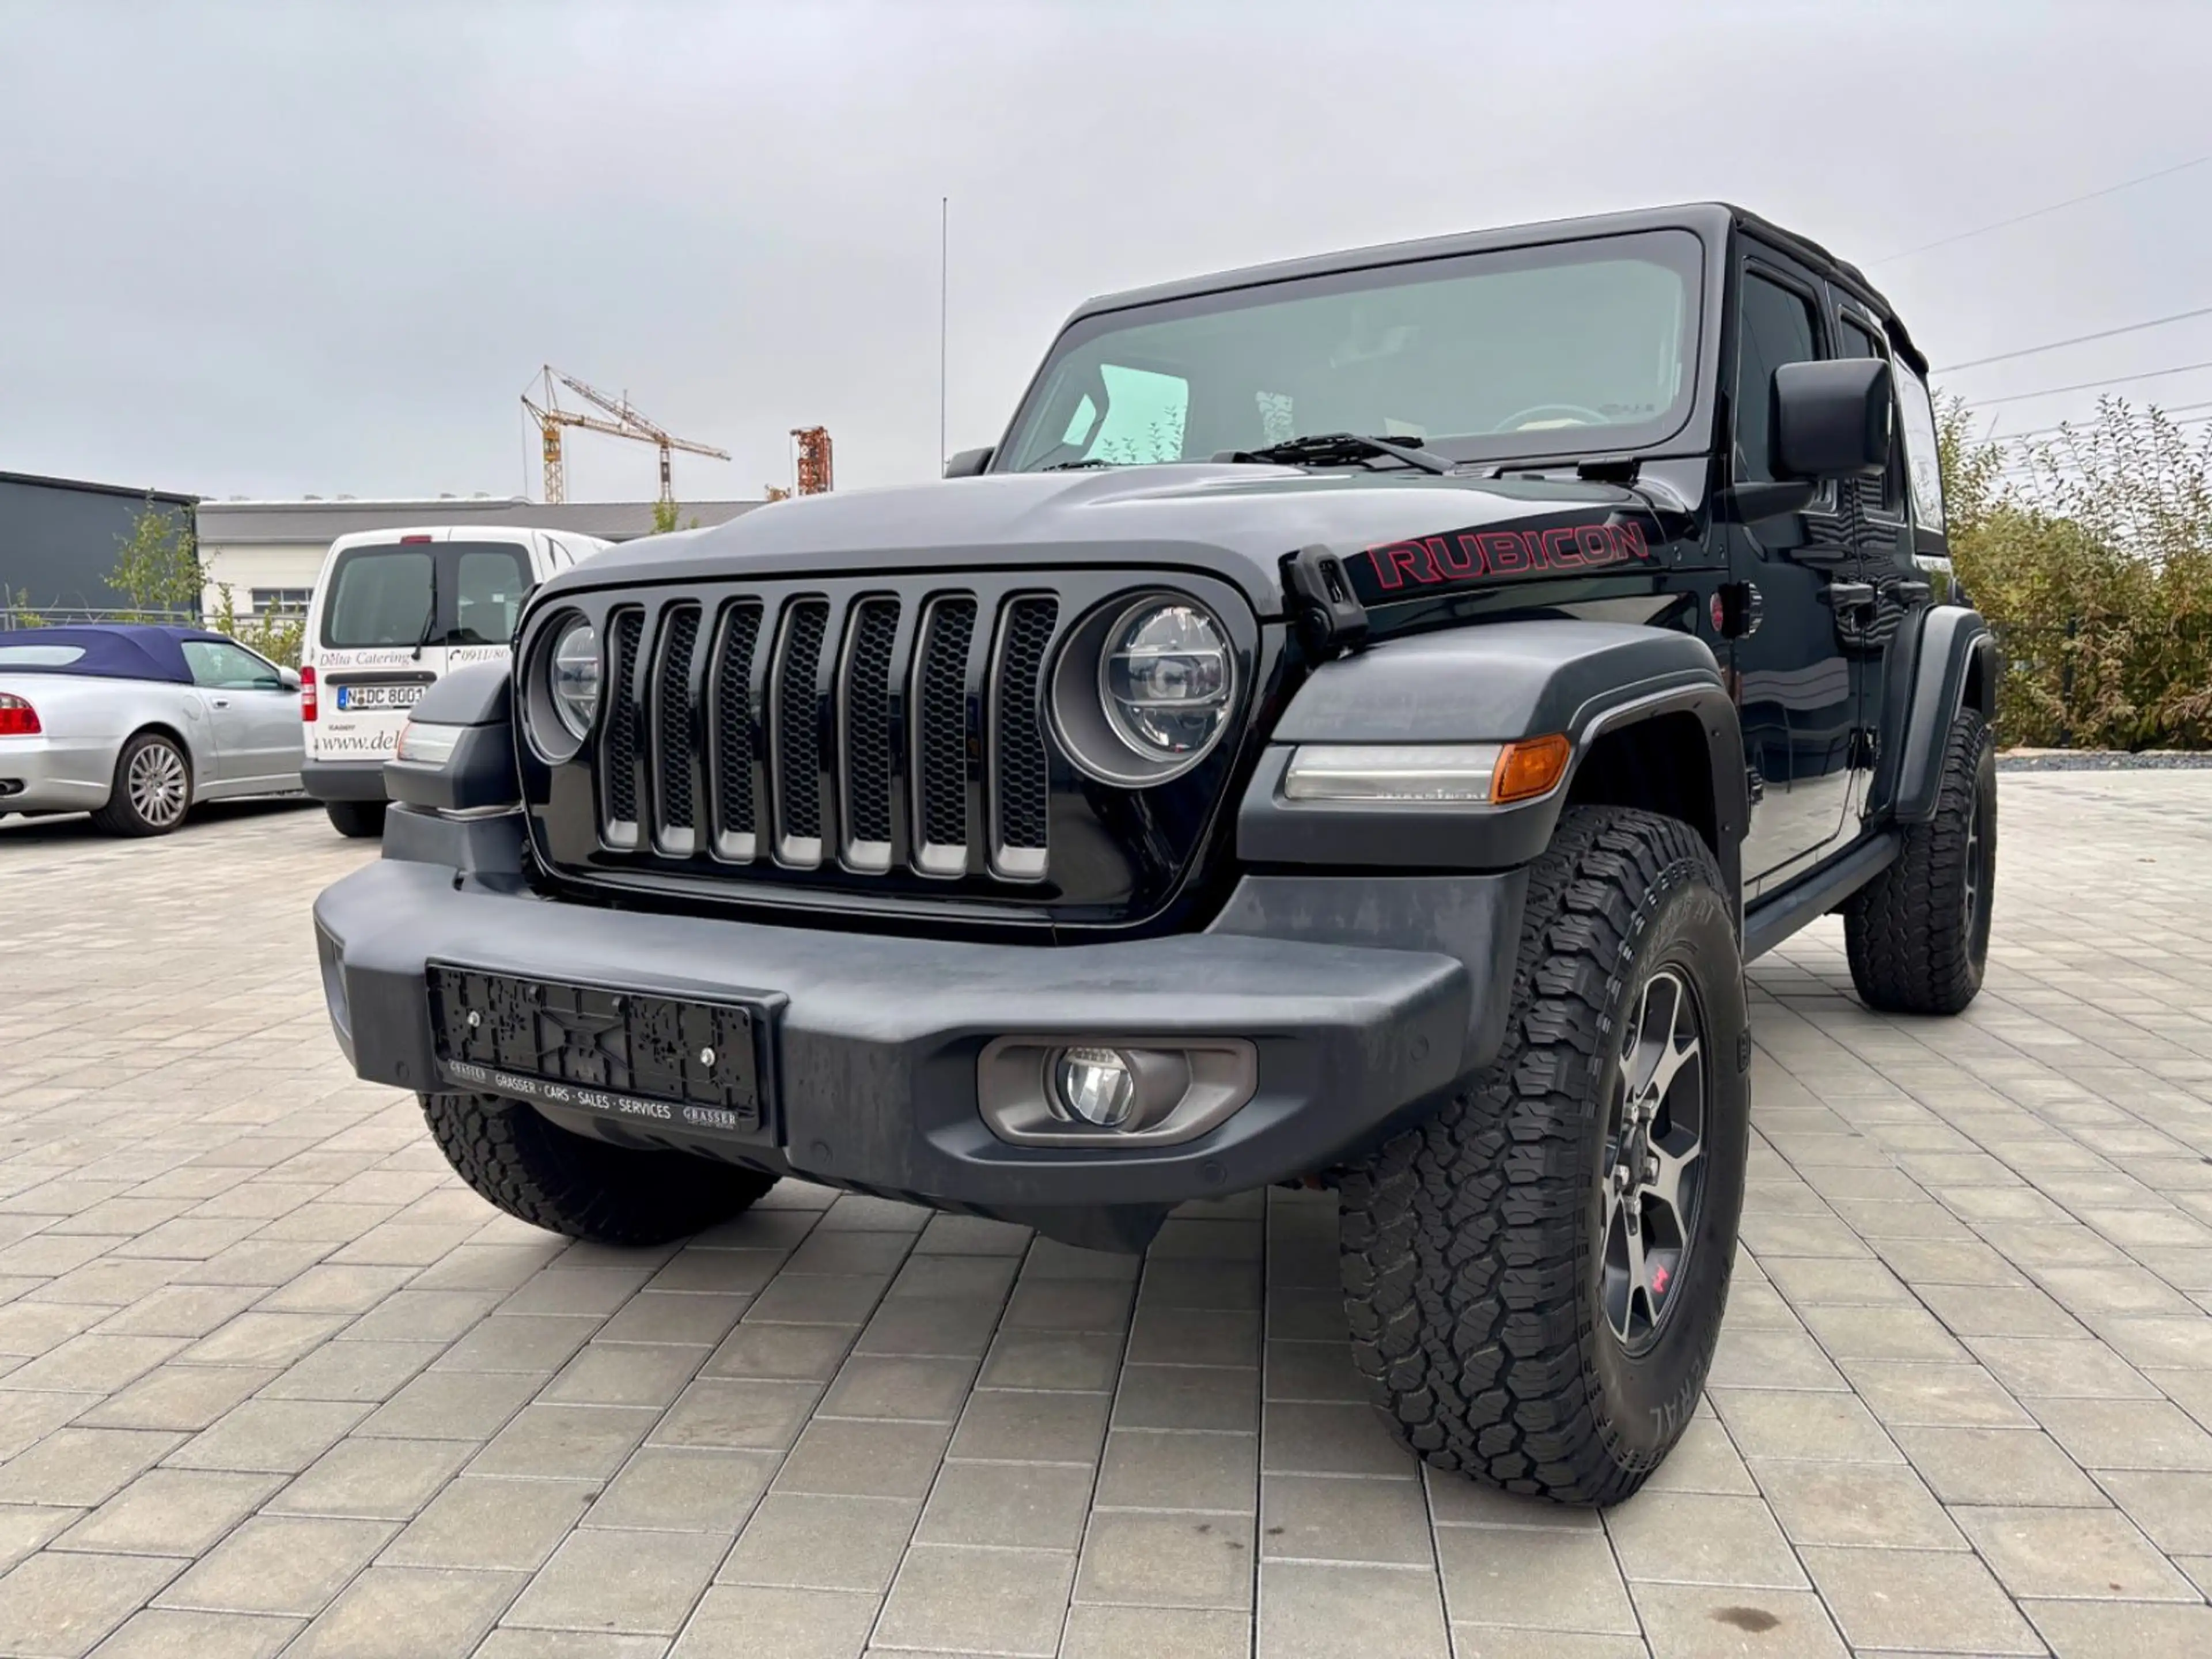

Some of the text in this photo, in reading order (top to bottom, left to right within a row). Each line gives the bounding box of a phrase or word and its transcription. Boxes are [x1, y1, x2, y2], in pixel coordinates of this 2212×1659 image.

[1368, 521, 1649, 589] RUBICON
[320, 651, 410, 667] Delta Catering
[347, 689, 357, 703] N
[366, 689, 385, 703] DC
[495, 1073, 537, 1094] GRASSER
[544, 1084, 570, 1102] CARS
[577, 1090, 610, 1109] SALES
[619, 1098, 672, 1120] SERVICES
